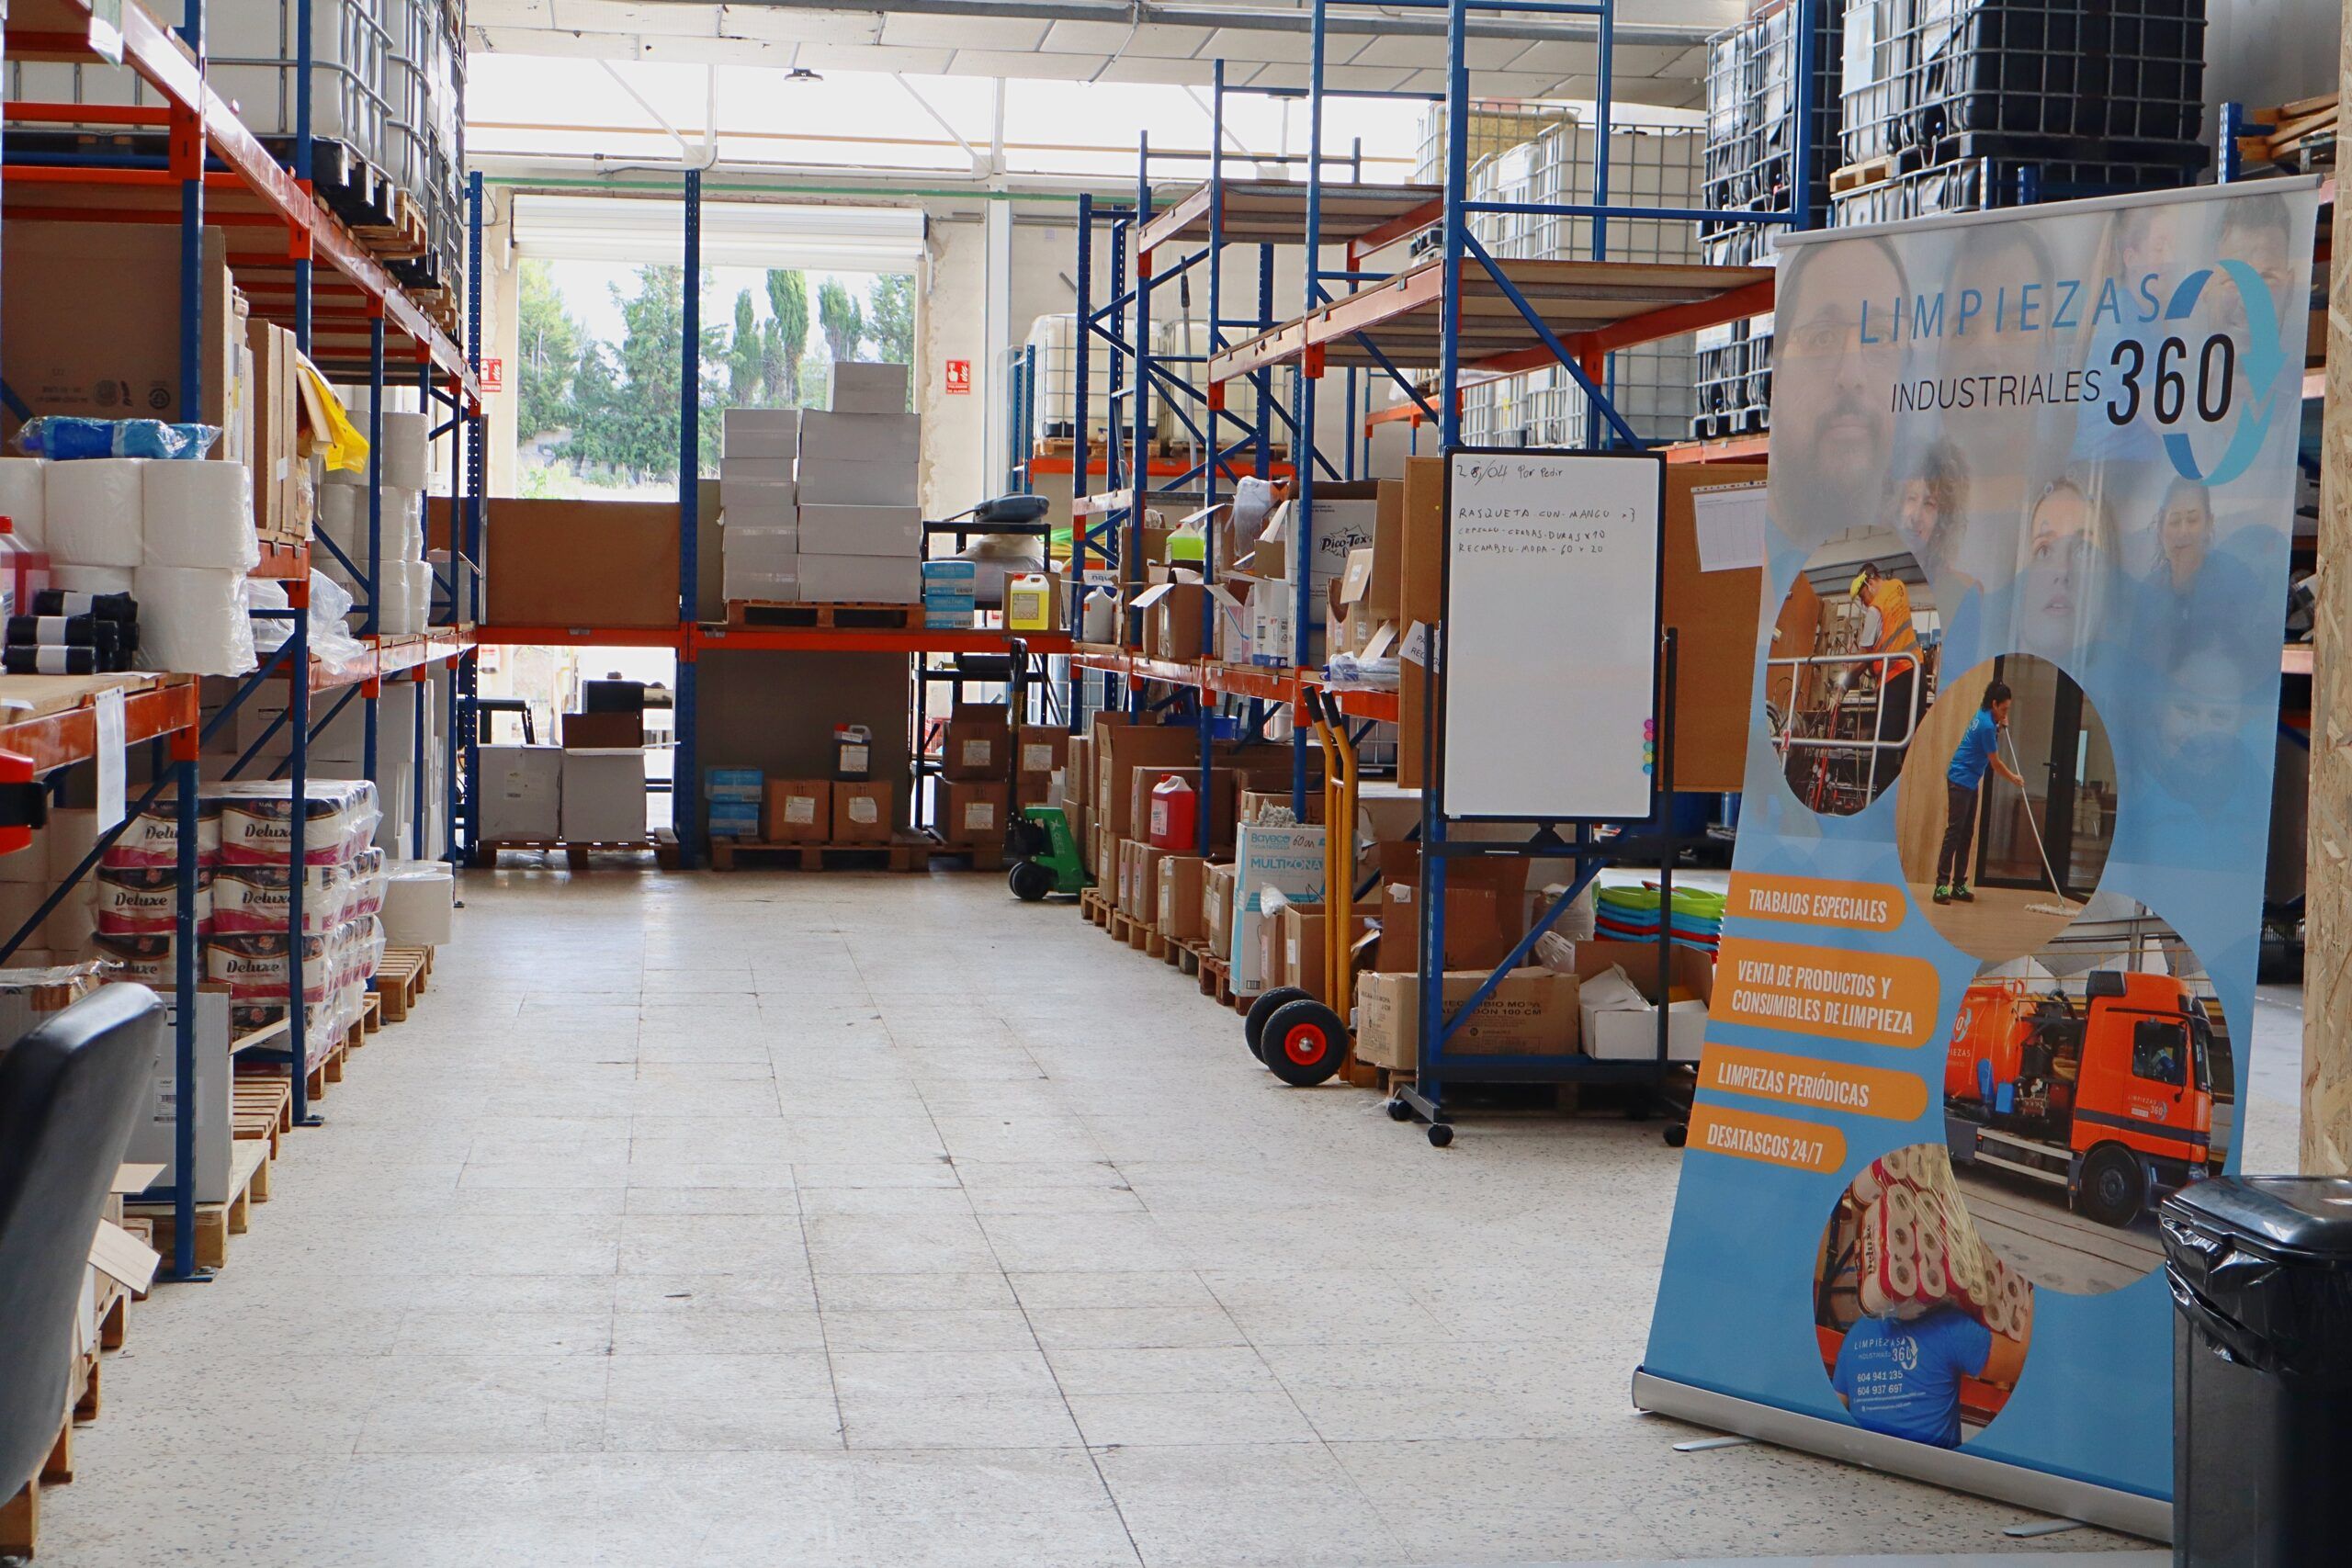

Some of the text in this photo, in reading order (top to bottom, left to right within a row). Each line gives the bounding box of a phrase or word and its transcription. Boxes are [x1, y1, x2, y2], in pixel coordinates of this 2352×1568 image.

[1860, 273, 2160, 344] LIMPIEZAS
[1891, 333, 2235, 425] INDUSTRIALES 360
[1458, 508, 1530, 519] RASQUETA
[145, 825, 177, 840] Delu
[1250, 858, 1324, 871] MULTIZONA
[115, 892, 168, 906] Deluxe
[1748, 888, 1888, 923] TRABAJOS ESPECIALES
[226, 959, 280, 973] Deluxe
[1737, 959, 1893, 1000] VENTA DE PRODUCTOS Y
[1731, 989, 1913, 1034] CONSUMIBLES DE LIMPIEZA
[1717, 1062, 1870, 1108] LIMPIEZAS PERIÓDICAS
[1706, 1123, 1824, 1165] DESATASCOS 24/7
[1892, 1347, 1912, 1361] 360
[1857, 1372, 1871, 1382] 604
[1872, 1371, 1887, 1381] 941
[1857, 1383, 1903, 1395] 604 937 697
